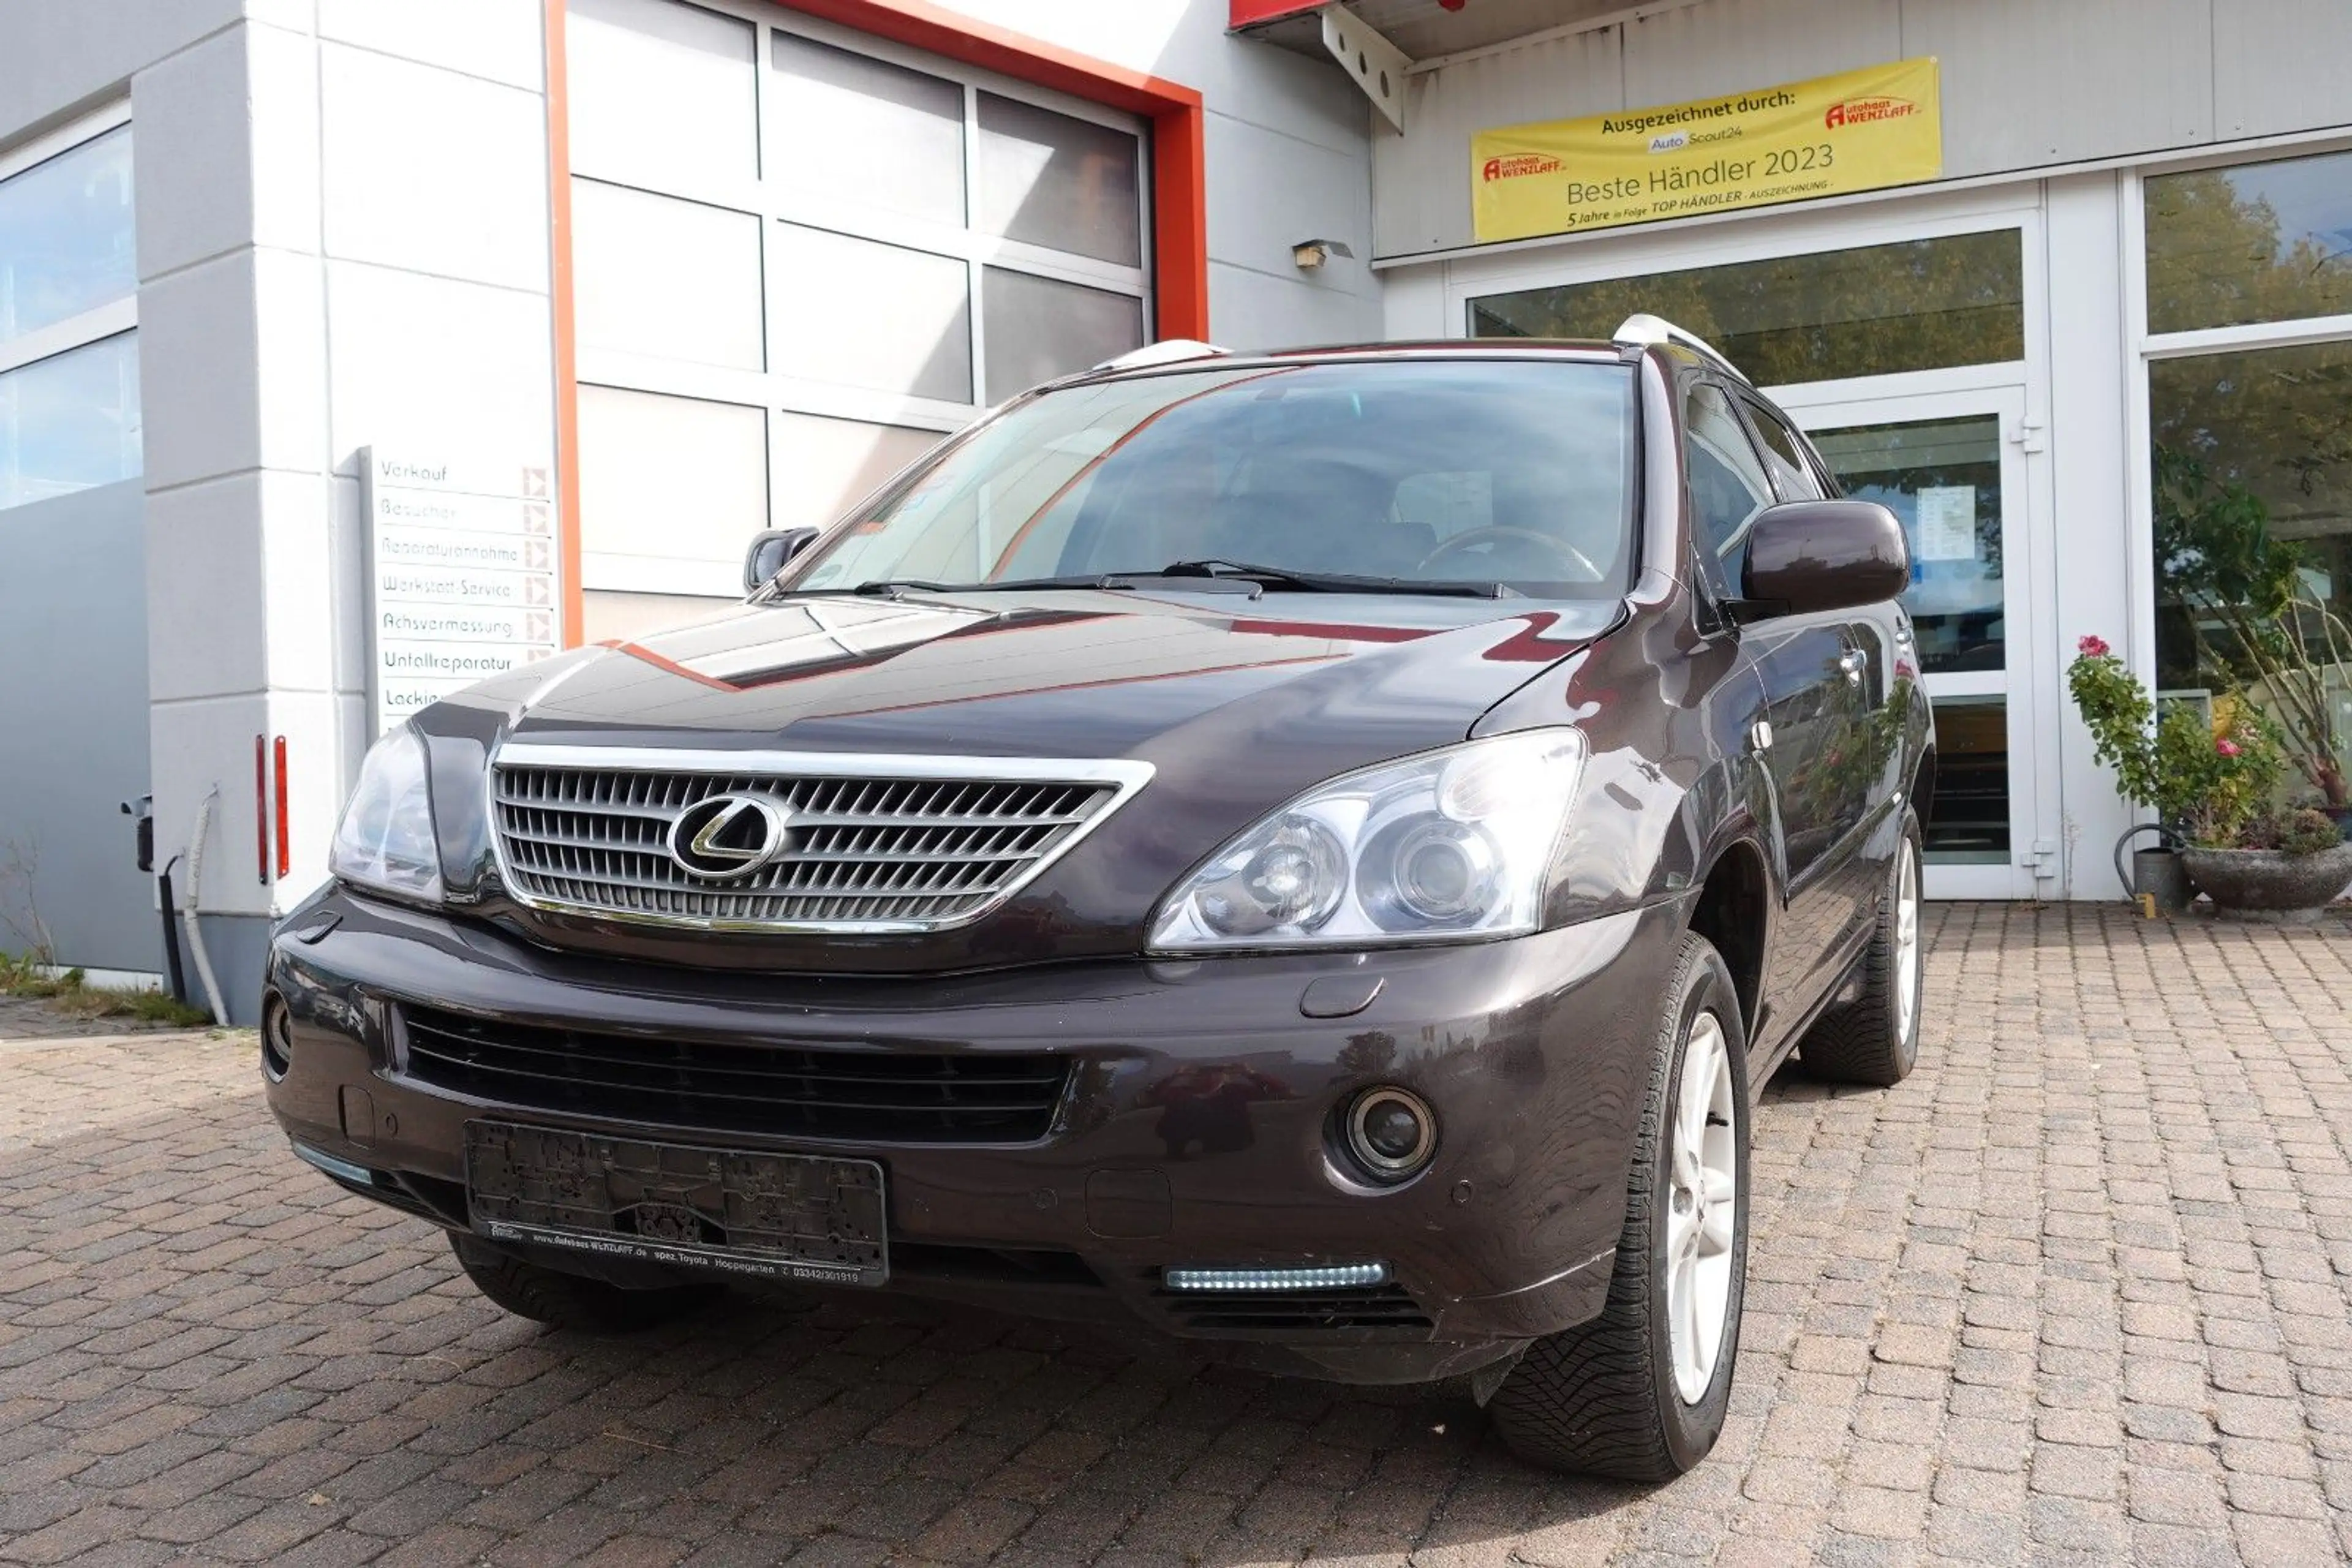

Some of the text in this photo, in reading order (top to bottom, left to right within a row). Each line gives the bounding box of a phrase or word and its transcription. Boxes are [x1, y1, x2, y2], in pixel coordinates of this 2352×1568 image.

[1602, 91, 1796, 134] Ausgezeichnet durch:
[1847, 104, 1915, 124] WENZLAFF
[1651, 126, 1742, 149] Auto Scout24
[1501, 160, 1561, 178] WENZLAFF
[1567, 143, 1833, 205] Beste Händler 2023
[1567, 213, 1578, 227] 5
[1578, 210, 1610, 224] Jahre
[1624, 208, 1648, 219] Folge
[1652, 200, 1677, 213] TOP
[1680, 190, 1742, 210] HÄNDLER
[381, 459, 447, 481] Verkauf
[383, 612, 513, 638] Achsvermessung
[385, 650, 512, 674] Unfallreparatur
[680, 1255, 708, 1265] Toyota
